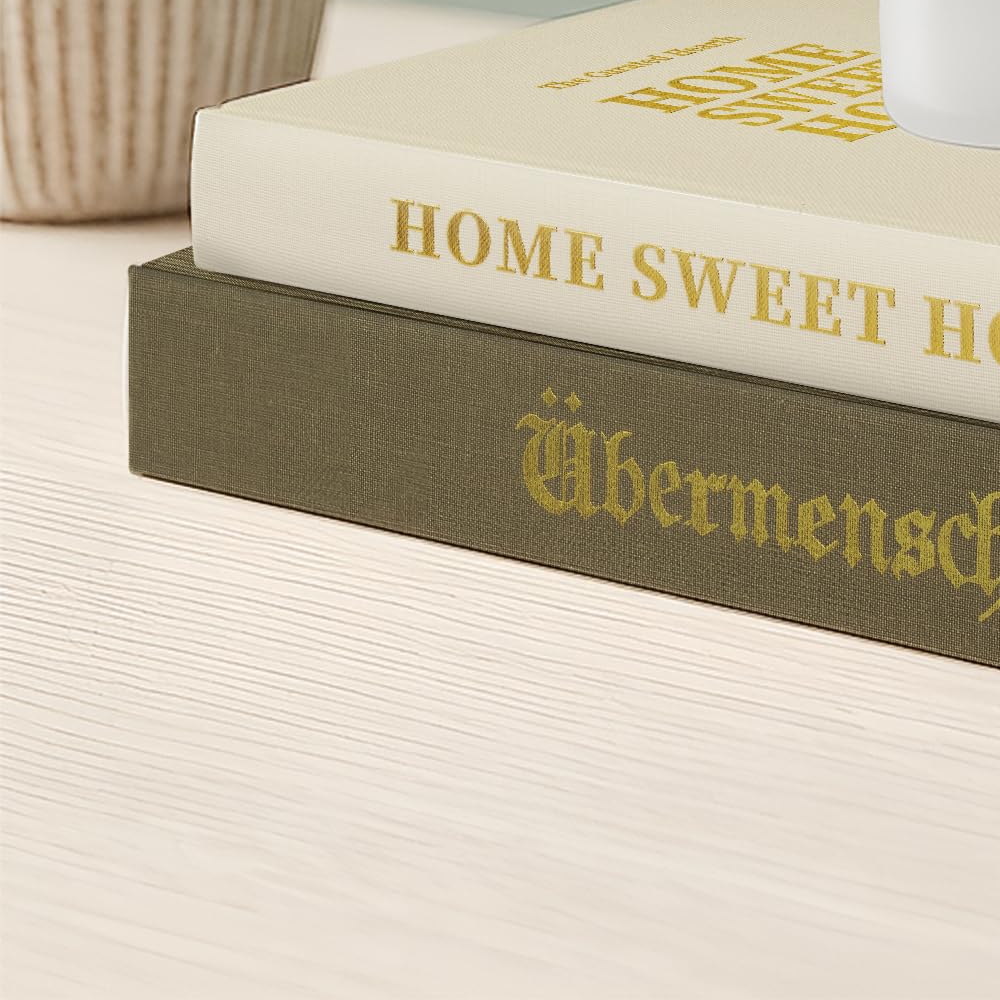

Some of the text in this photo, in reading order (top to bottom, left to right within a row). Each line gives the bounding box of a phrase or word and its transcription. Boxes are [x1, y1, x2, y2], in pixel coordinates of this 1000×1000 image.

[537, 36, 744, 89] The Curated Hearth
[599, 42, 874, 114] HOME
[697, 58, 883, 127] SWEE
[391, 199, 604, 291] HOME
[632, 243, 896, 345] SWEET
